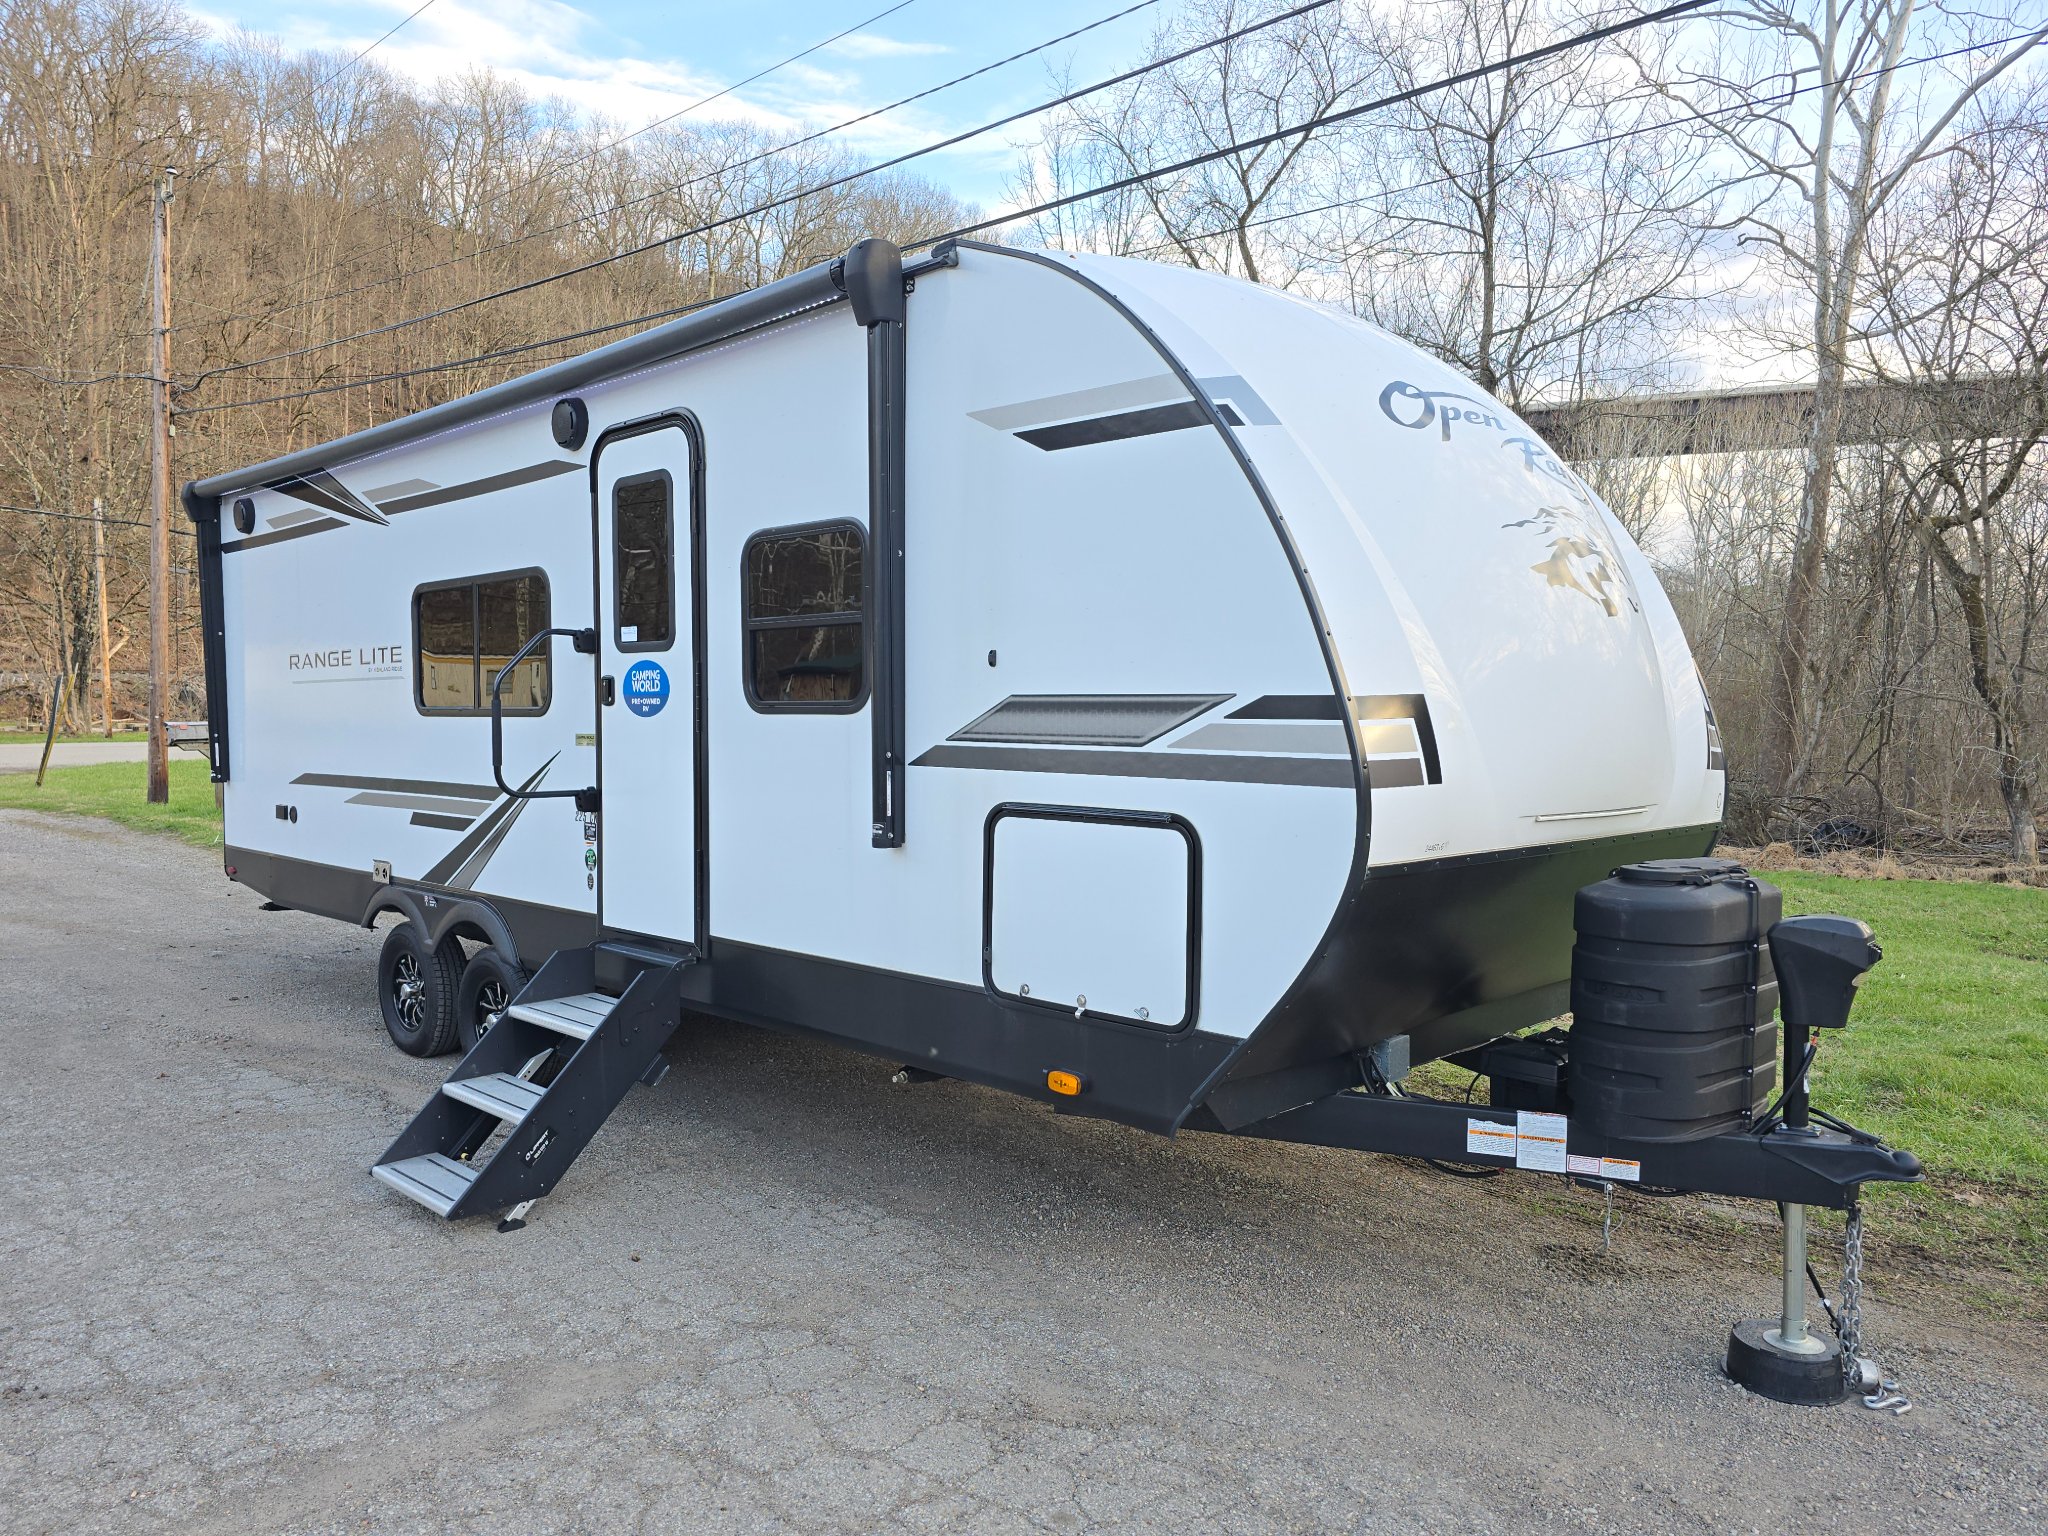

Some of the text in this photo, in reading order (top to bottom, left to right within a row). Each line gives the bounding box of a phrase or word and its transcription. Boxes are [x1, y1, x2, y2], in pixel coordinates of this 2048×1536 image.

[1378, 380, 1508, 442] Open
[289, 646, 402, 670] RANGE LITE
[631, 669, 660, 680] CAMPING
[631, 680, 660, 692] WORLD
